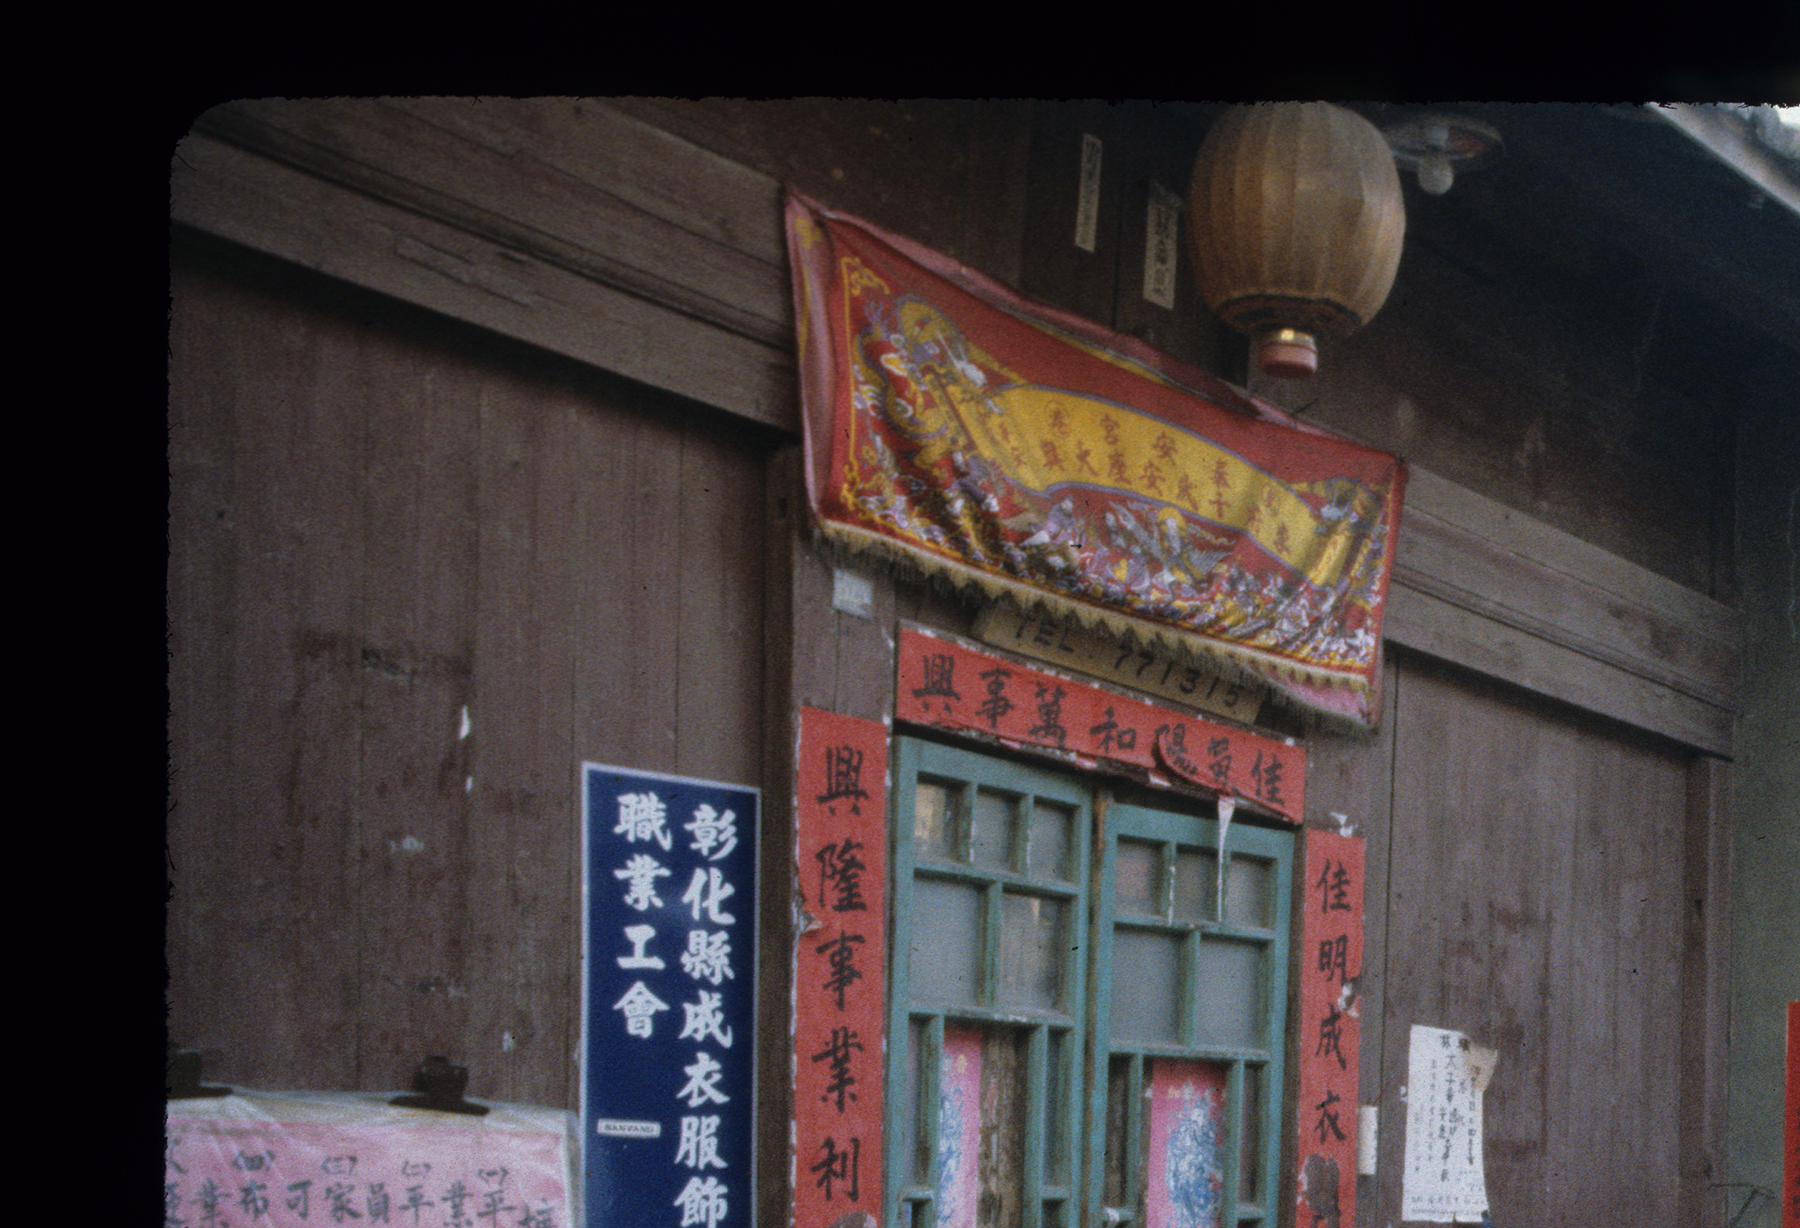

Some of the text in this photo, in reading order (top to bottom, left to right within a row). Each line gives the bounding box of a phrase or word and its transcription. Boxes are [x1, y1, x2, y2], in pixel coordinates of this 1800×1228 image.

[612, 791, 673, 1039] 職業工會
[810, 744, 869, 1202] 興隆事業利
